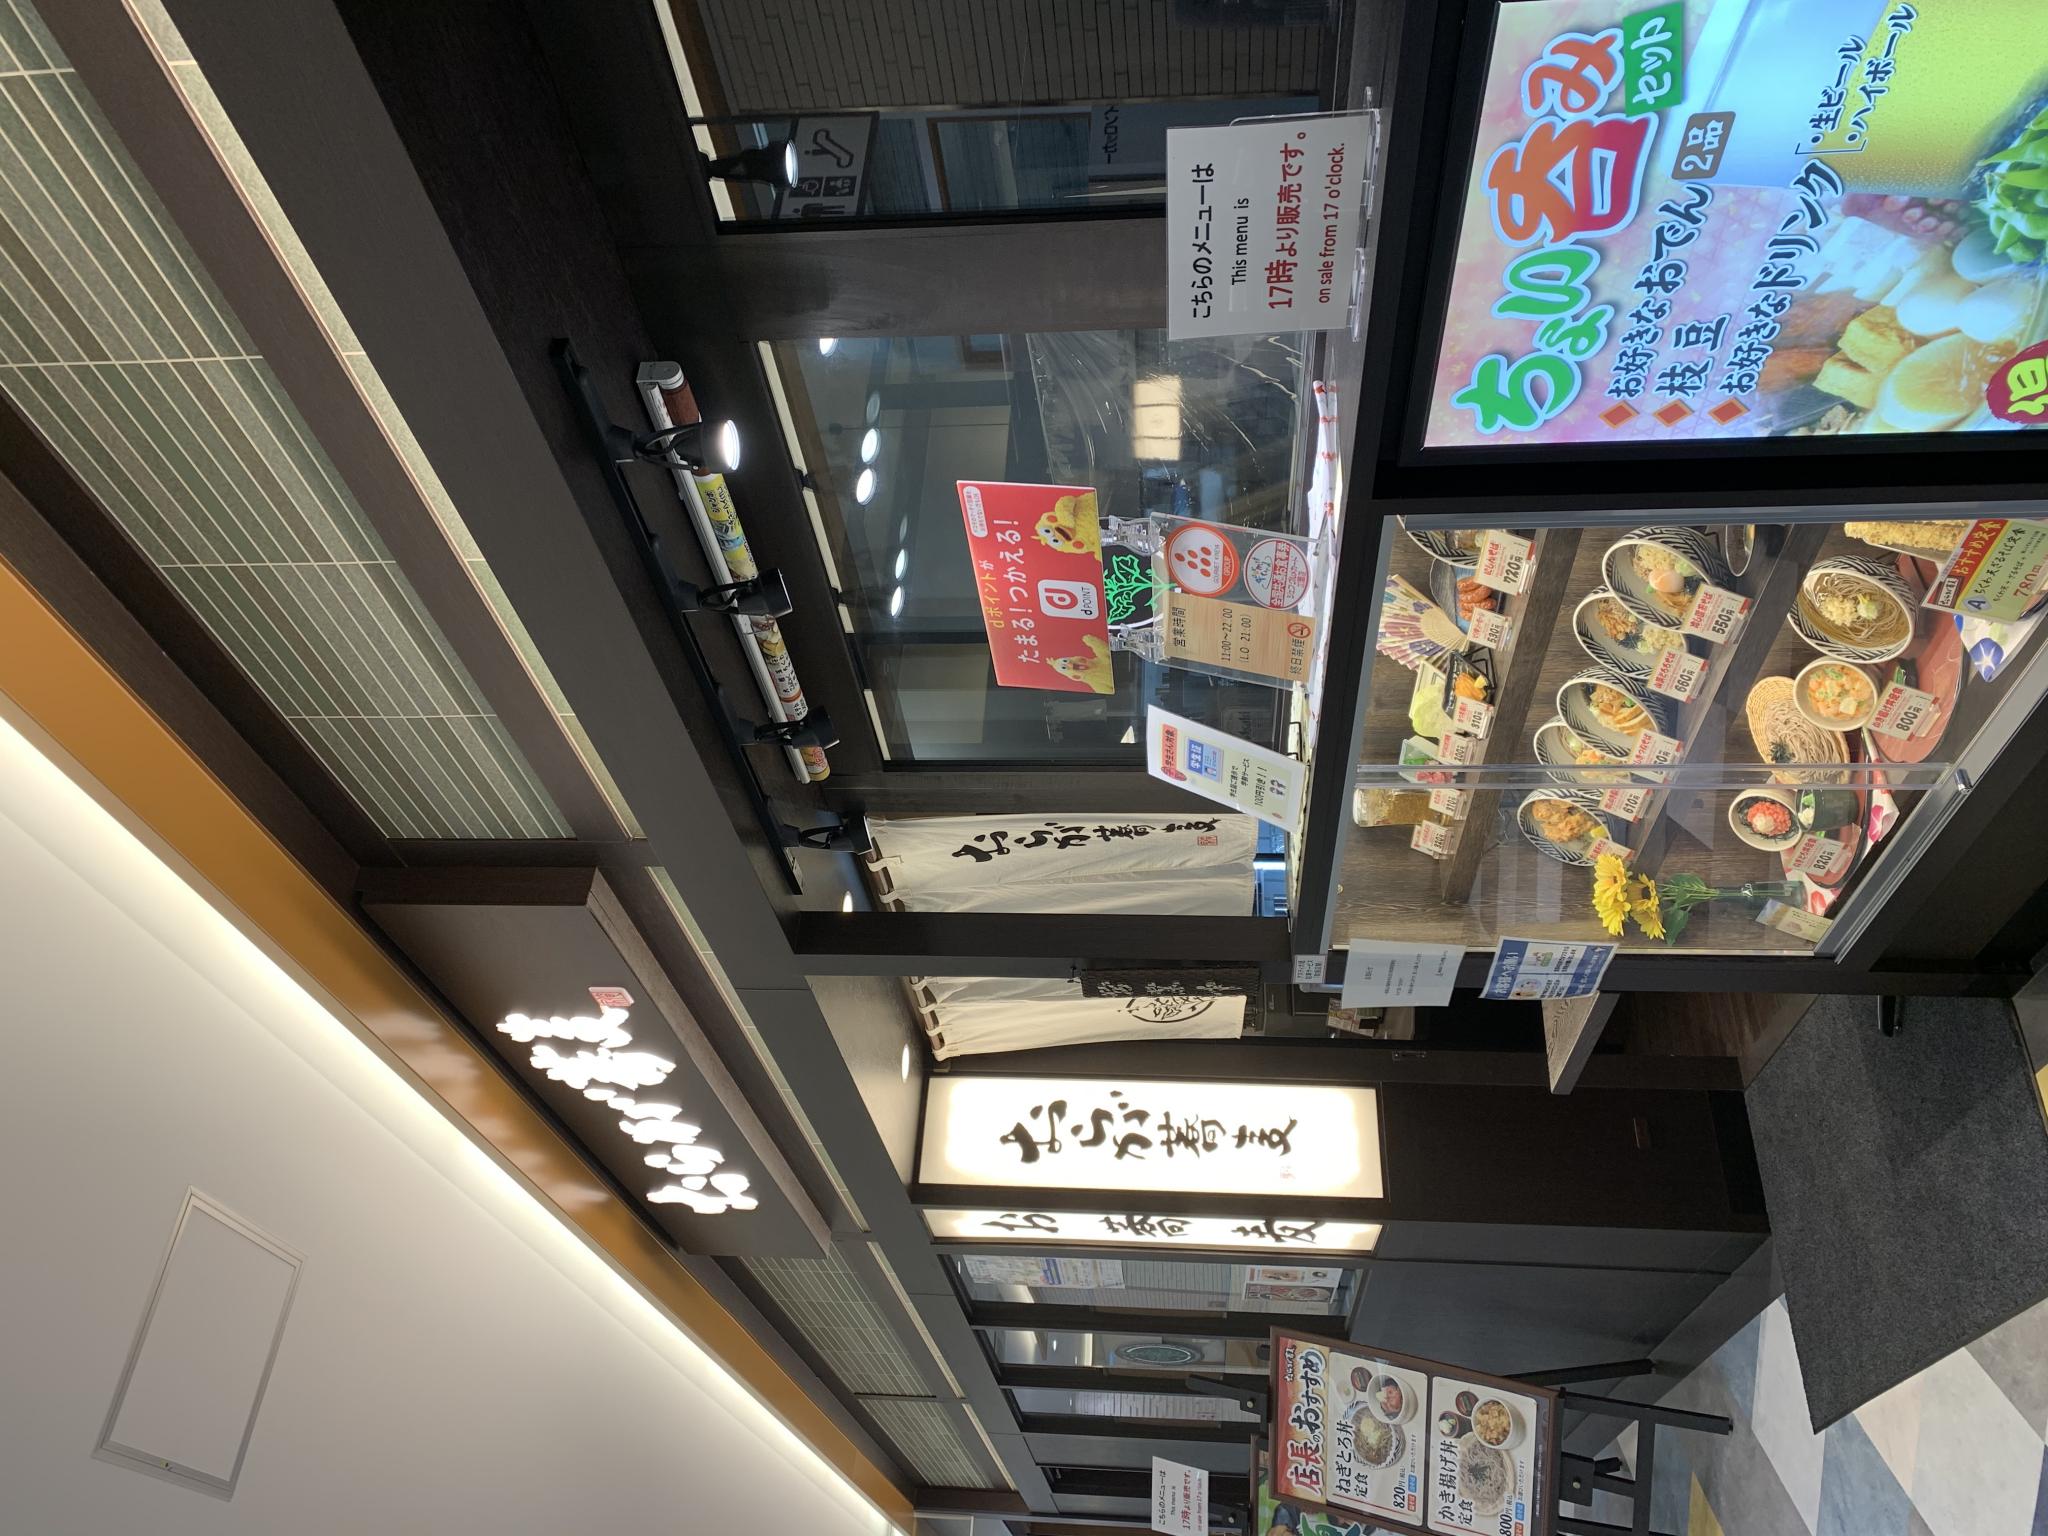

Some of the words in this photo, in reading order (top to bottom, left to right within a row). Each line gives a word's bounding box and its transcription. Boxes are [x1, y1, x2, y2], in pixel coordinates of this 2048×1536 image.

[1633, 14, 1673, 105] セット
[1325, 142, 1345, 198] o'clock.
[1233, 198, 1249, 209] is
[1264, 132, 1307, 309] 17時より販売です。
[1323, 203, 1339, 220] 17
[1191, 163, 1215, 319] こちらのメニューは
[1236, 216, 1249, 256] menu
[1319, 224, 1338, 257] from
[1454, 33, 1649, 429] ちょい呑み
[1231, 259, 1247, 286] This
[1317, 261, 1334, 284] sale
[1608, 184, 1711, 399] お好きなおでん
[1680, 118, 1725, 173] 2品
[1721, 159, 1843, 396] お好きなドリンク
[1318, 288, 1331, 303] on
[1655, 315, 1731, 399] 枝豆
[1271, 541, 1290, 606] 全国共通お食事券
[1482, 542, 1500, 577] にしんそば
[1951, 521, 2002, 575] おすすめ定食
[1973, 527, 2027, 595] ちくわ天ざるそば定食
[979, 560, 1005, 628] dポイントが
[993, 519, 1040, 663] たまる！つかえる！
[1081, 586, 1093, 609] POINT
[1967, 599, 1986, 610] A
[1171, 606, 1187, 648] 営業時間
[1288, 638, 1306, 675] 終日禁煙
[1165, 729, 1175, 767] 学生さん対象
[1190, 743, 1202, 770] 学生証
[951, 817, 1222, 862] おらが蕎麦
[999, 1090, 1298, 1164] おらが蕎麦
[1289, 1349, 1323, 1494] 店長のおすすめ
[1335, 1420, 1353, 1494] ねぎとろ丼
[1438, 1439, 1458, 1522] かき揚げ丼
[1158, 1470, 1166, 1525] こちらのメニューは
[1354, 1473, 1368, 1498] 定食
[1458, 1499, 1473, 1526] 定食
